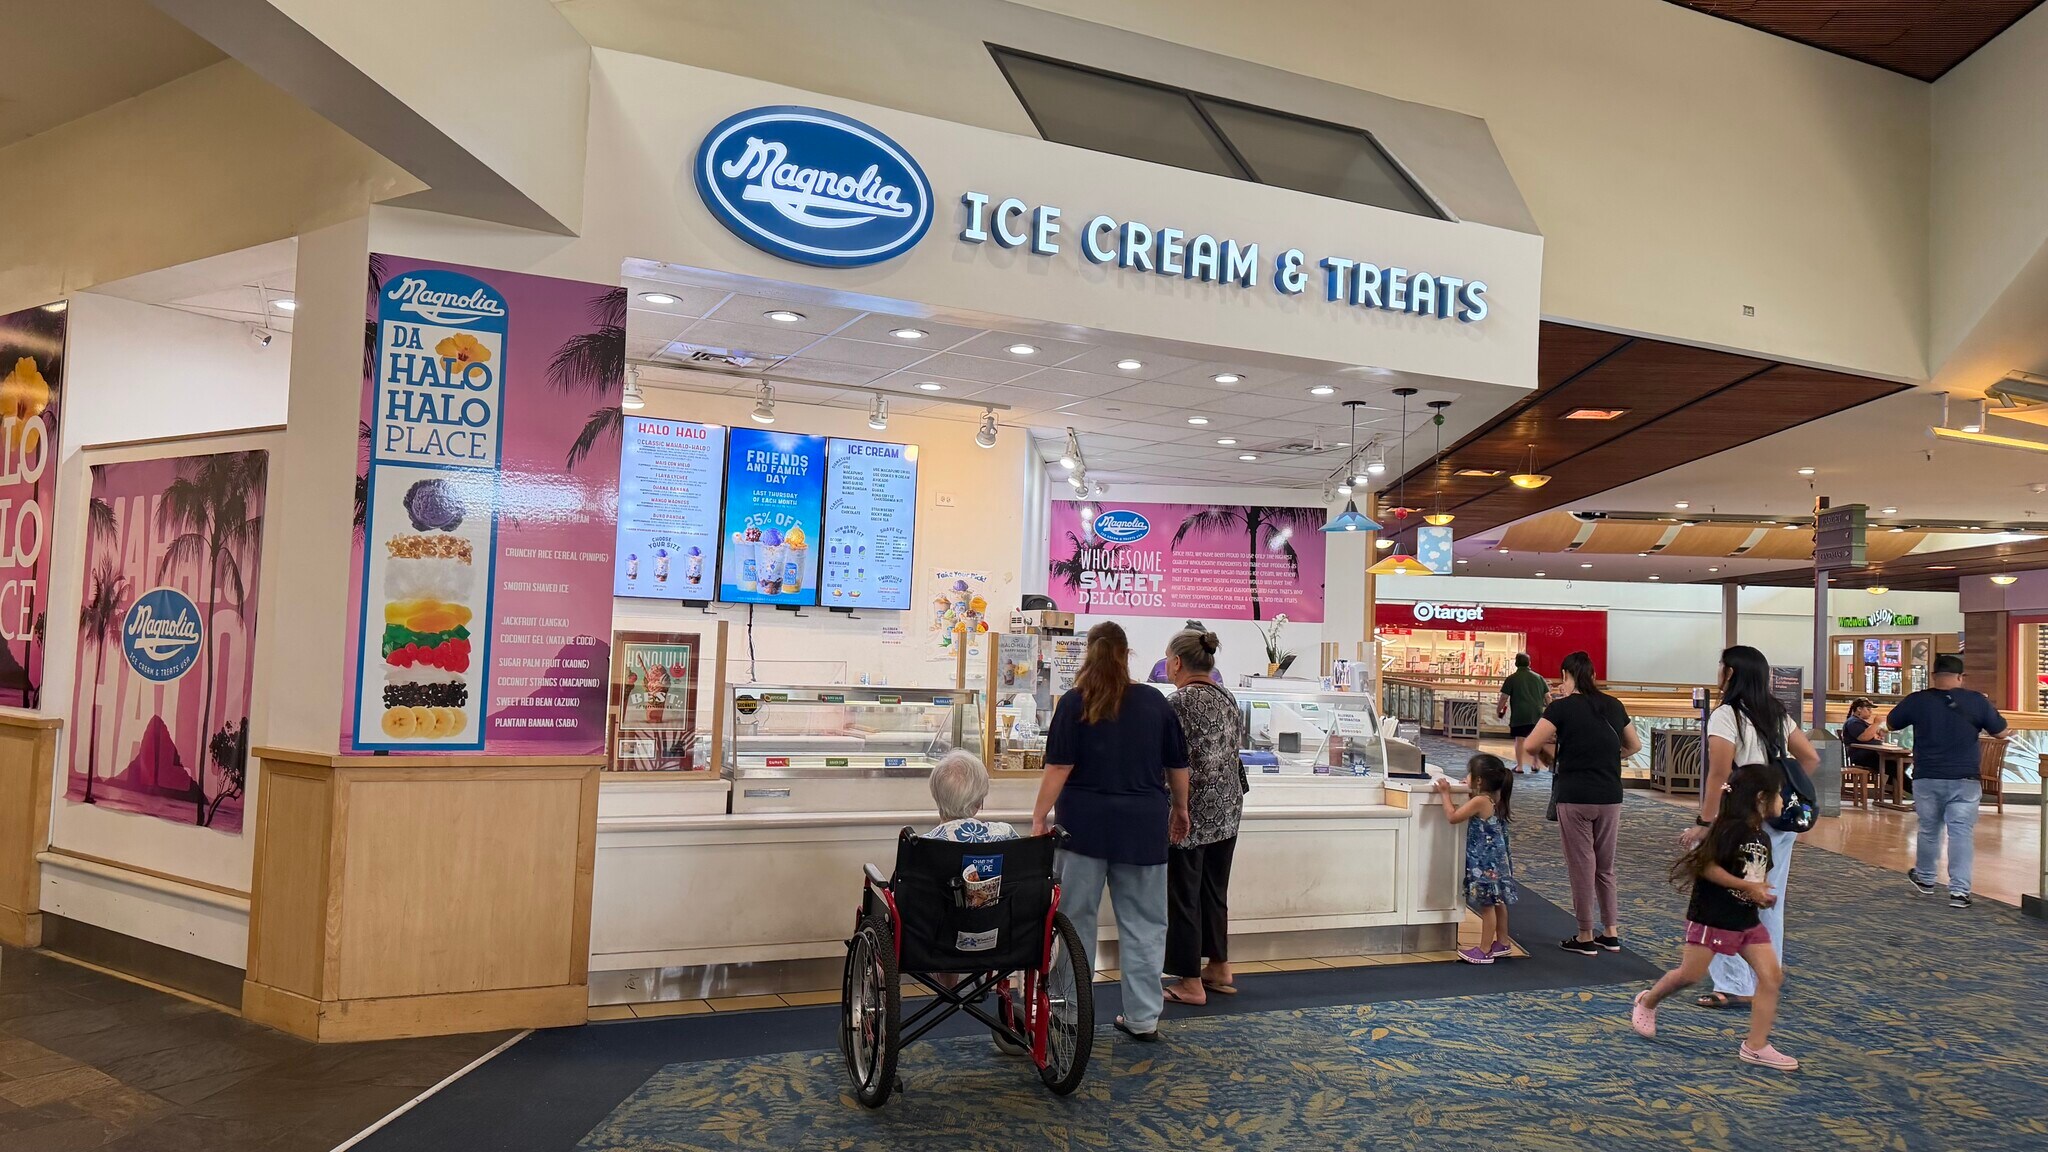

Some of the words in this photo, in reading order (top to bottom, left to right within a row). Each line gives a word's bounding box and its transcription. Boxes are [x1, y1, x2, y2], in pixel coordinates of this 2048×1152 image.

[721, 136, 913, 229] Magnolia
[962, 191, 1062, 255] ICE
[1082, 215, 1258, 288] CREAM
[1275, 248, 1308, 295] &
[1321, 256, 1488, 323] TREATS
[388, 277, 505, 325] Magnolia
[391, 325, 424, 350] DA
[387, 353, 493, 392] HALO
[386, 390, 491, 427] HALO
[638, 423, 670, 435] HALO
[676, 427, 706, 440] HALO
[384, 424, 487, 460] PLACE
[641, 439, 665, 447] CLASSIC
[747, 450, 809, 468] FRIENDS
[848, 444, 863, 455] ICE
[865, 446, 899, 458] CREAM
[746, 463, 768, 473] AND
[770, 465, 808, 476] FAMILY
[766, 474, 788, 484] DAY
[768, 491, 798, 499] THURSDAY
[568, 514, 589, 523] CREAM
[744, 512, 772, 527] 25%
[776, 513, 803, 528] OFF
[1098, 516, 1147, 535] Magnolia
[648, 541, 666, 549] YOUR
[666, 543, 681, 552] SIZE
[505, 548, 537, 558] CRUNCHY
[538, 550, 552, 559] RICE
[554, 550, 578, 561] CEREAL
[579, 552, 609, 562] (PINIPIG)
[1080, 548, 1167, 573] WHOLESOME.
[503, 581, 531, 592] SMOOTH
[532, 582, 558, 593] SHAVED
[559, 584, 569, 593] ICE
[1080, 571, 1167, 593] SWEET.
[1078, 591, 1166, 607] DELICIOUS.
[501, 616, 537, 626] JACKFRUIT
[538, 617, 570, 628] (LANGKA)
[1434, 606, 1483, 622] target
[1838, 617, 1867, 628] Windward
[1868, 609, 1893, 626] VISION
[1894, 615, 1915, 626] Center
[128, 605, 199, 661] Magnolia
[500, 634, 530, 644] COCONUT
[532, 635, 544, 644] GEL
[546, 636, 565, 645] (NATA
[566, 636, 574, 645] DE
[576, 637, 596, 646] COCO)
[129, 652, 138, 665] ICE
[138, 661, 154, 676] CREAM
[161, 664, 180, 676] TREATS
[180, 656, 191, 669] USA
[499, 657, 521, 667] SUGAR
[522, 658, 540, 667] PALM
[541, 659, 561, 668] FRUIT
[562, 659, 590, 669] (KAONG)
[627, 650, 686, 668] HONOLULU
[497, 677, 528, 686] COCONUT
[529, 678, 558, 687] STRINGS
[559, 678, 600, 688] (MACAPUNO)
[495, 697, 519, 706] SWEET
[520, 697, 534, 706] RED
[535, 697, 553, 707] BEAN
[554, 698, 580, 707] (AZUKI)
[495, 718, 527, 727] PLANTAIN
[528, 718, 554, 728] BANANA
[555, 718, 579, 728] (SABA)
